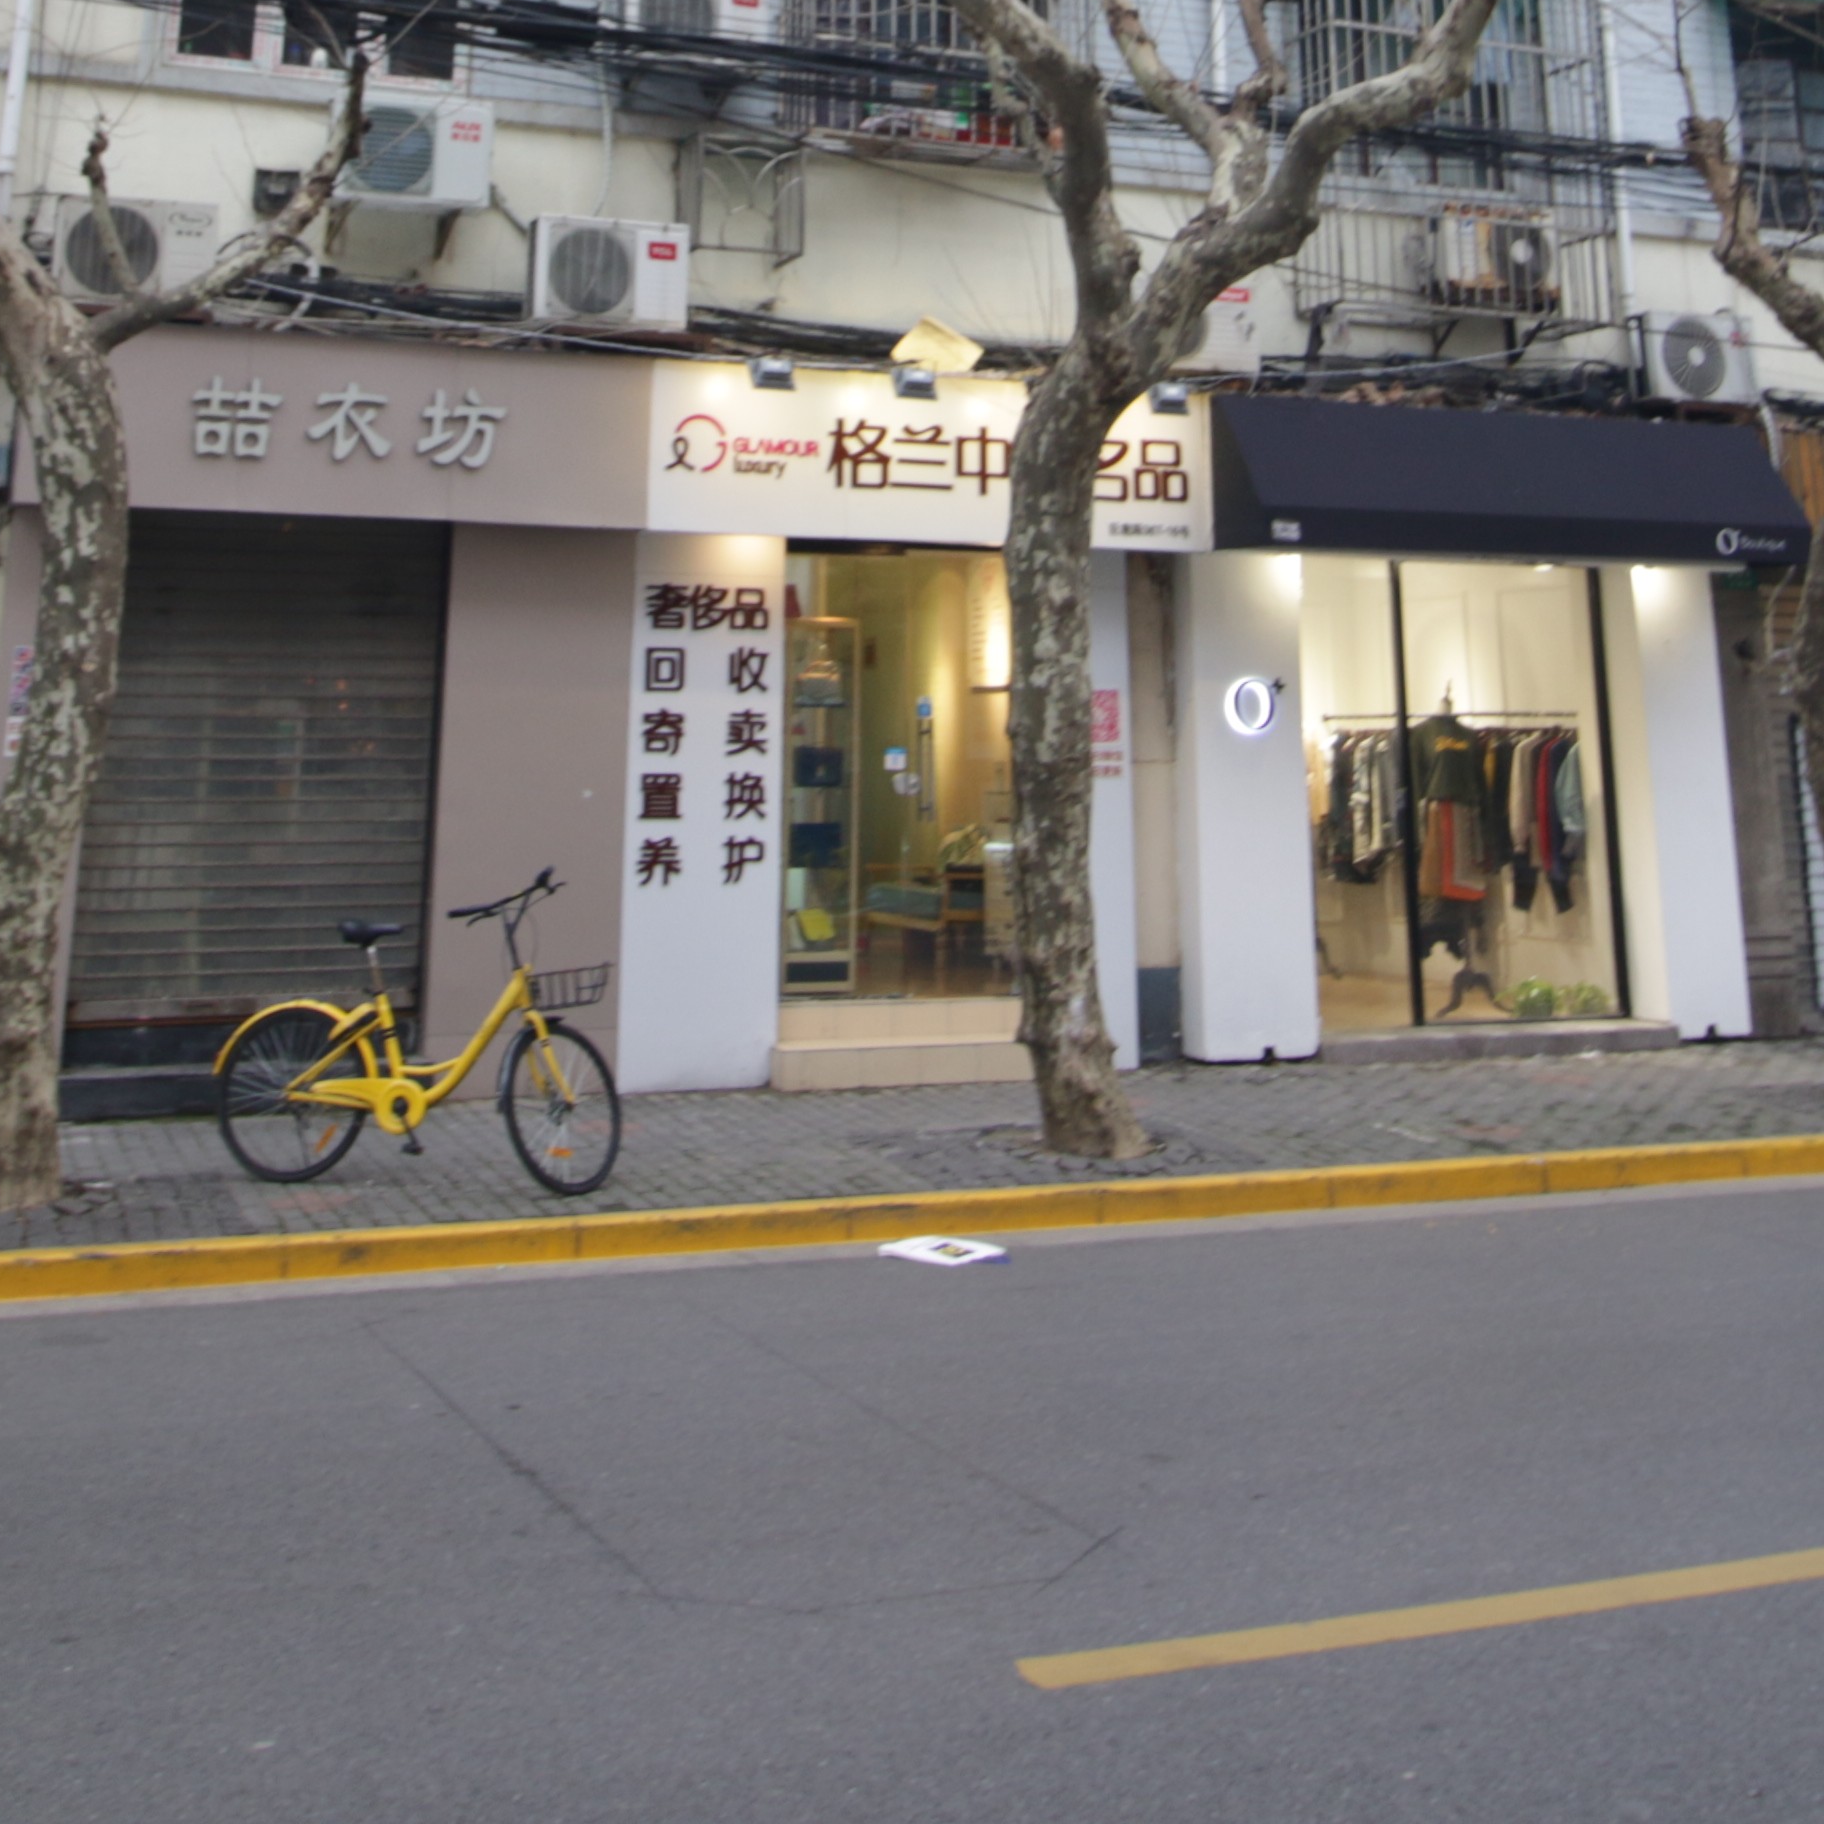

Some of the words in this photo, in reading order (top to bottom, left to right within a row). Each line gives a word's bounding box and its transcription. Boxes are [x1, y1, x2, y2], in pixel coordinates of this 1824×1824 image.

[191, 375, 509, 468] 喆衣坊
[733, 437, 819, 457] GLAMOUR
[733, 454, 786, 479] luxury
[645, 584, 769, 631] 奢侈品
